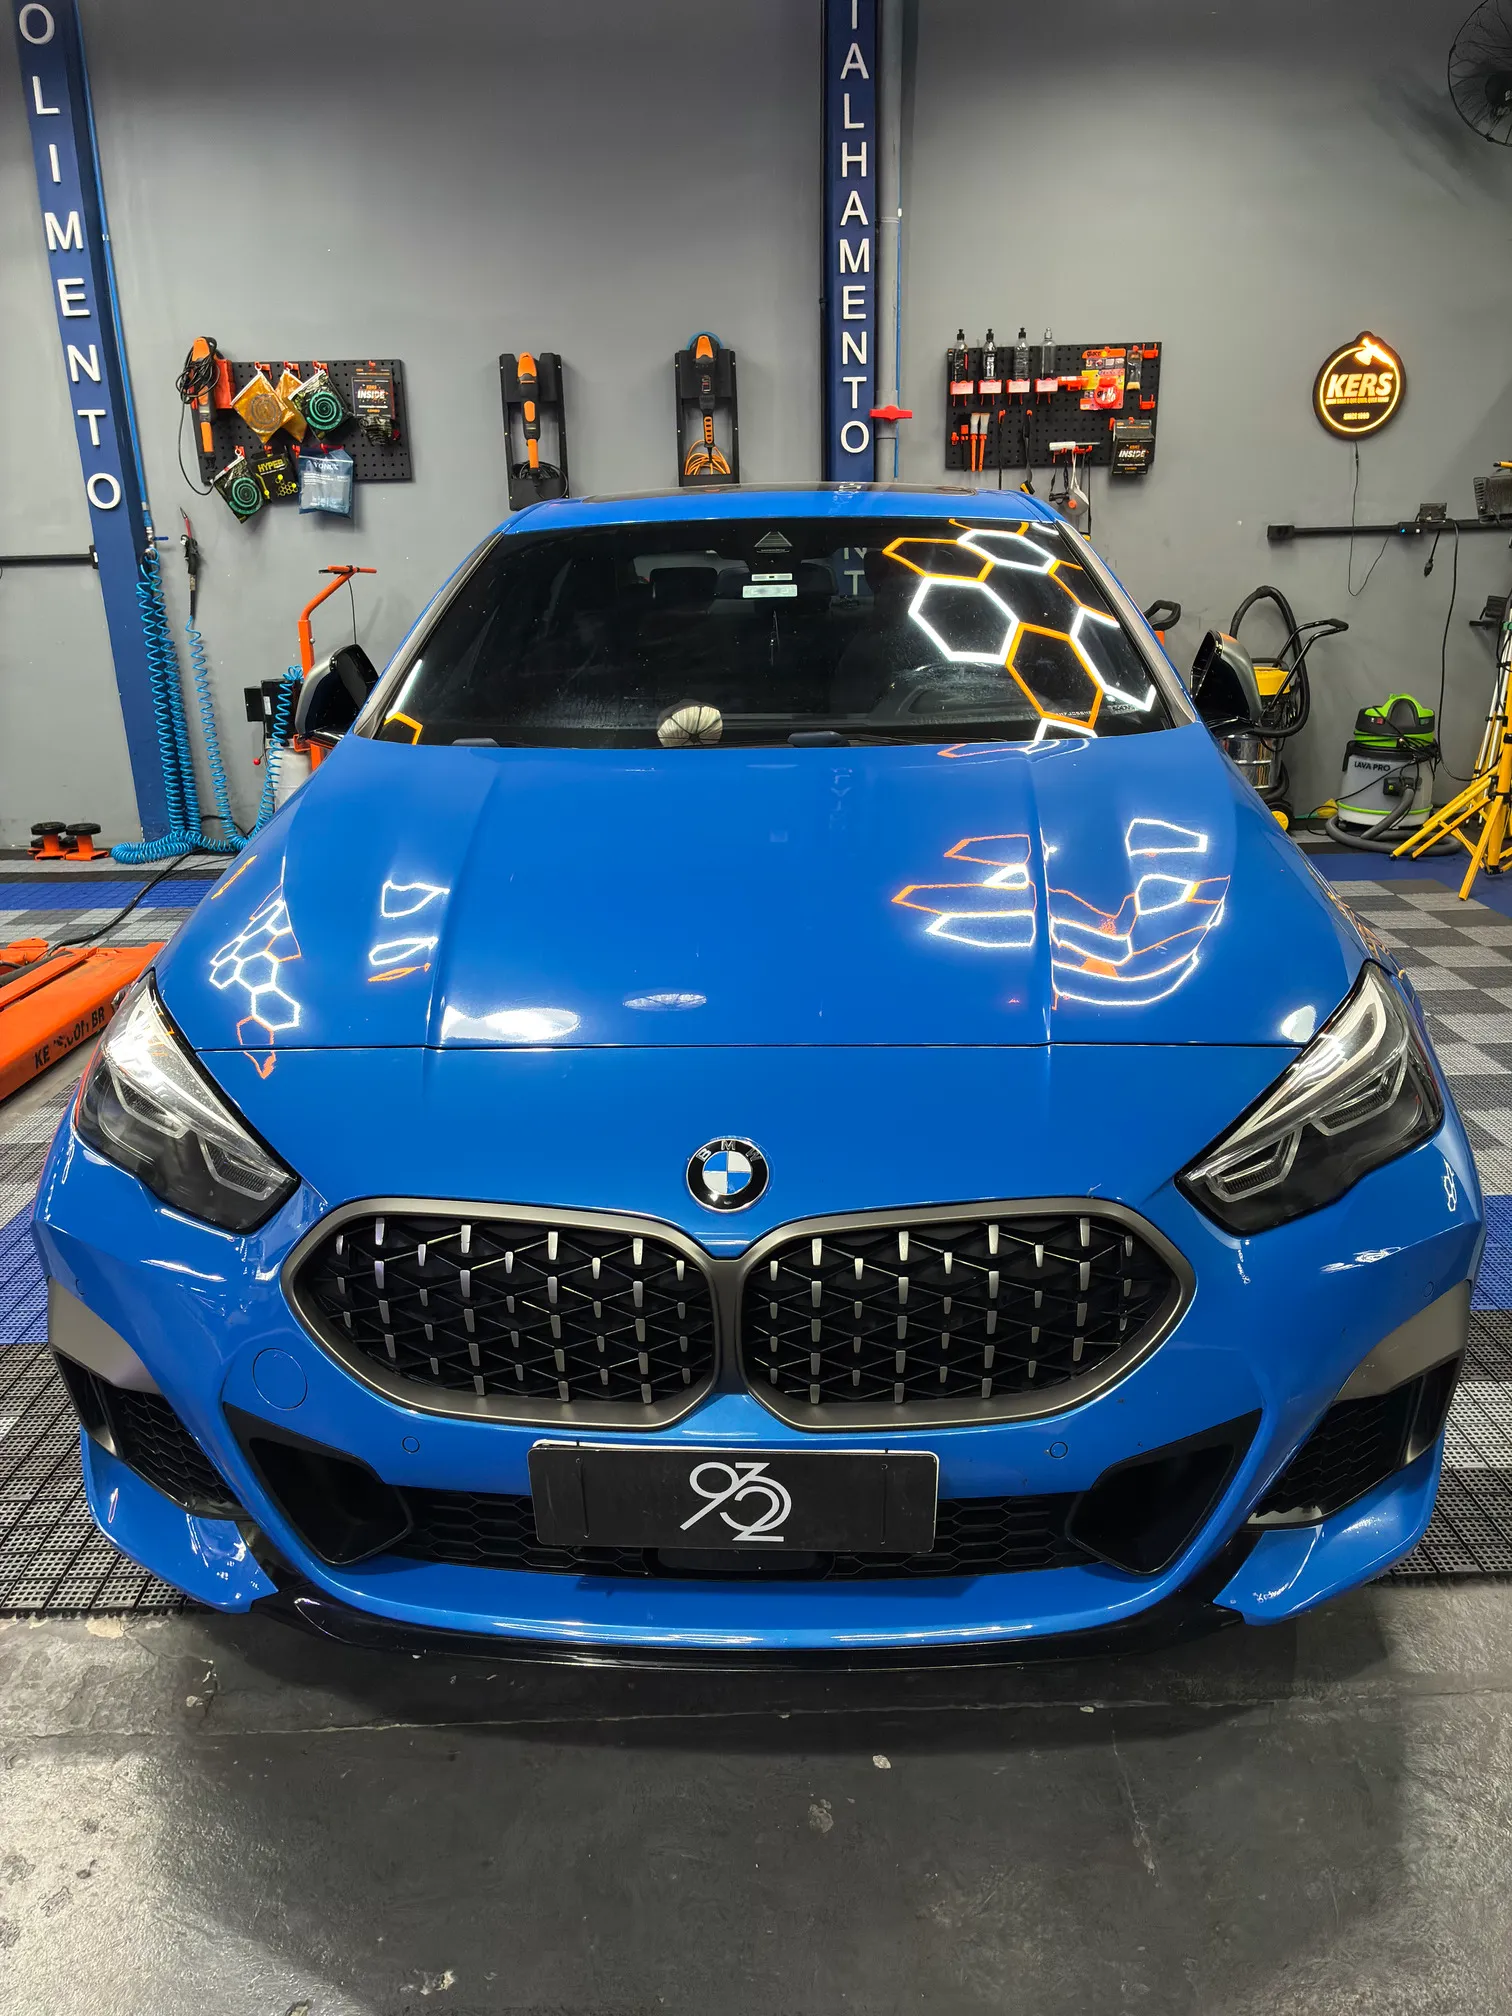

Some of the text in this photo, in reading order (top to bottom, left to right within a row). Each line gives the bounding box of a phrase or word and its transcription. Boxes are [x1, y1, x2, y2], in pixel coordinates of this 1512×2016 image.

[19, 3, 121, 511] OLIMENTO
[357, 389, 386, 399] INSIDE
[1325, 372, 1393, 399] KERS
[1118, 450, 1146, 458] INSIDE
[1354, 761, 1391, 772] LAVA PRO
[696, 1139, 764, 1162] BMW
